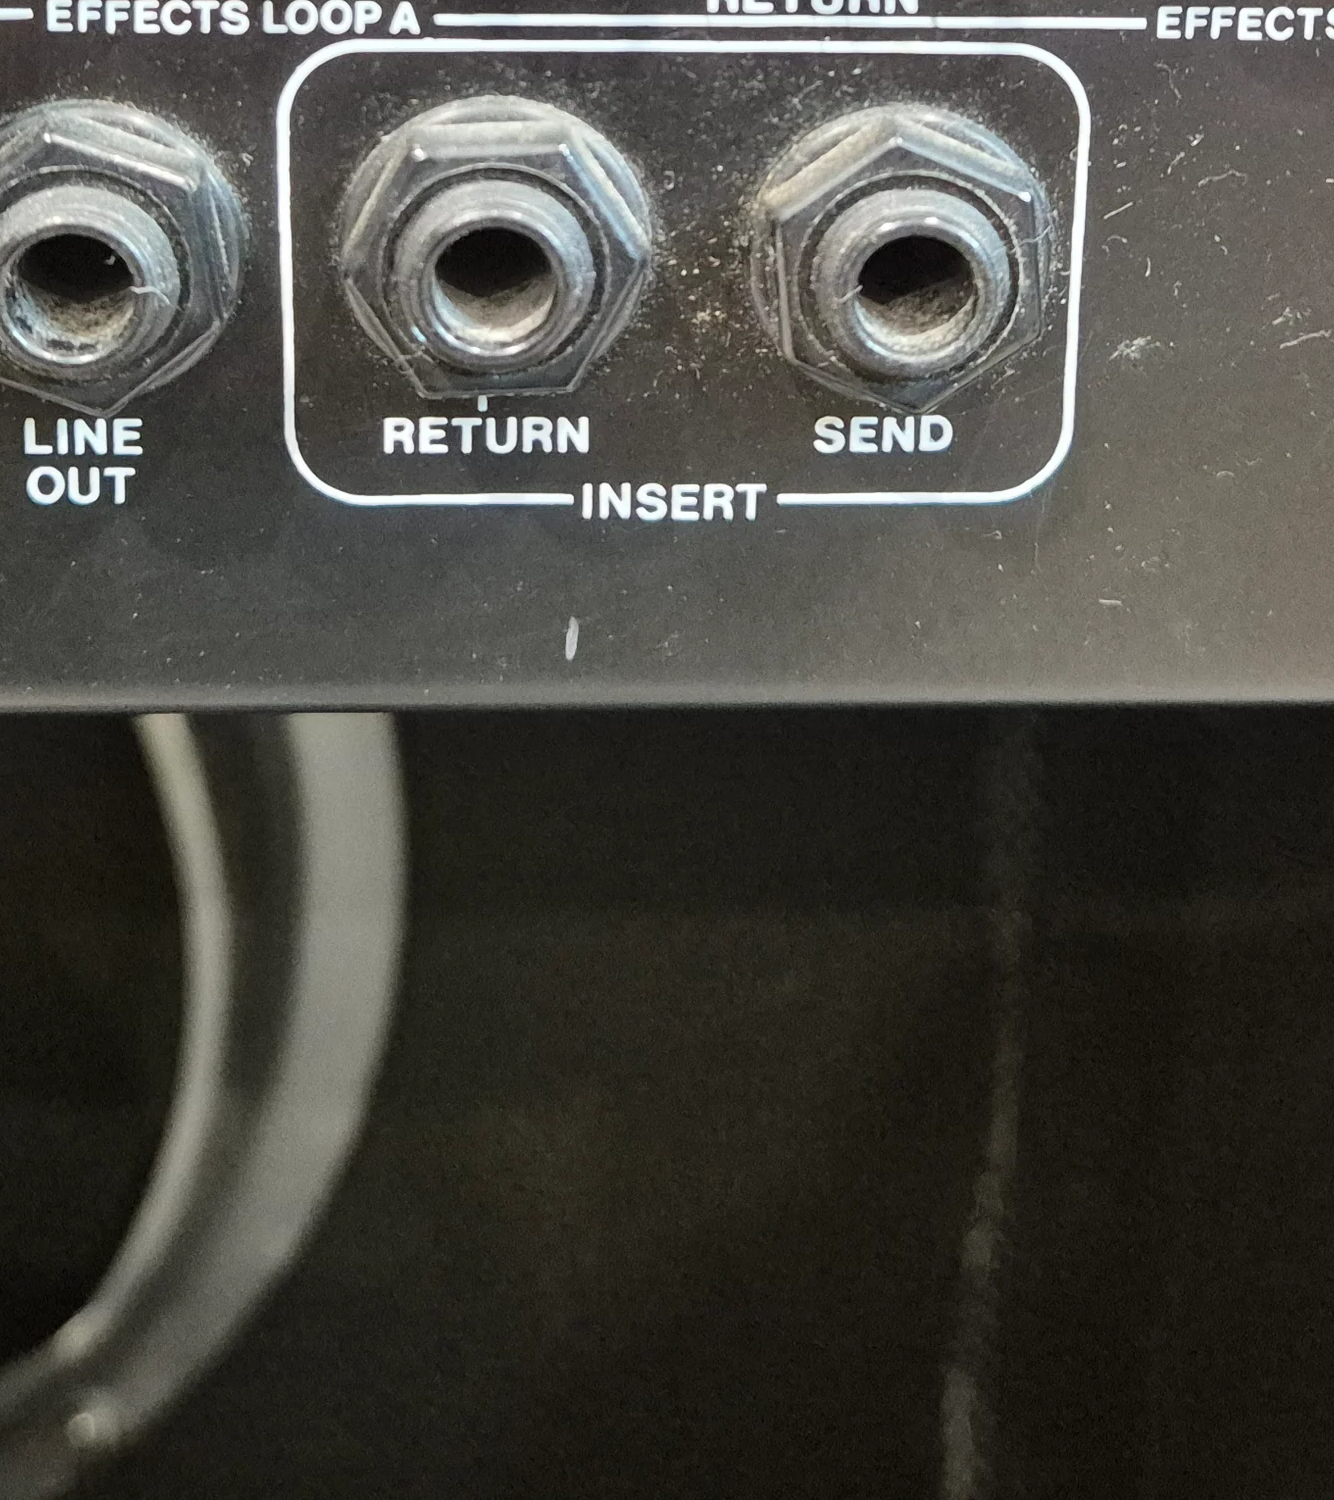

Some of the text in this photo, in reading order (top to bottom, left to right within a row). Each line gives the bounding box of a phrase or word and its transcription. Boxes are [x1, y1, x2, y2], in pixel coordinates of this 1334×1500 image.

[262, 0, 381, 36] LOOP
[389, 3, 421, 36] A
[22, 418, 144, 457] LINE
[382, 417, 589, 455] RETURN
[812, 417, 953, 454] SEND
[25, 467, 136, 505] OUT
[581, 483, 768, 521] INSERT
